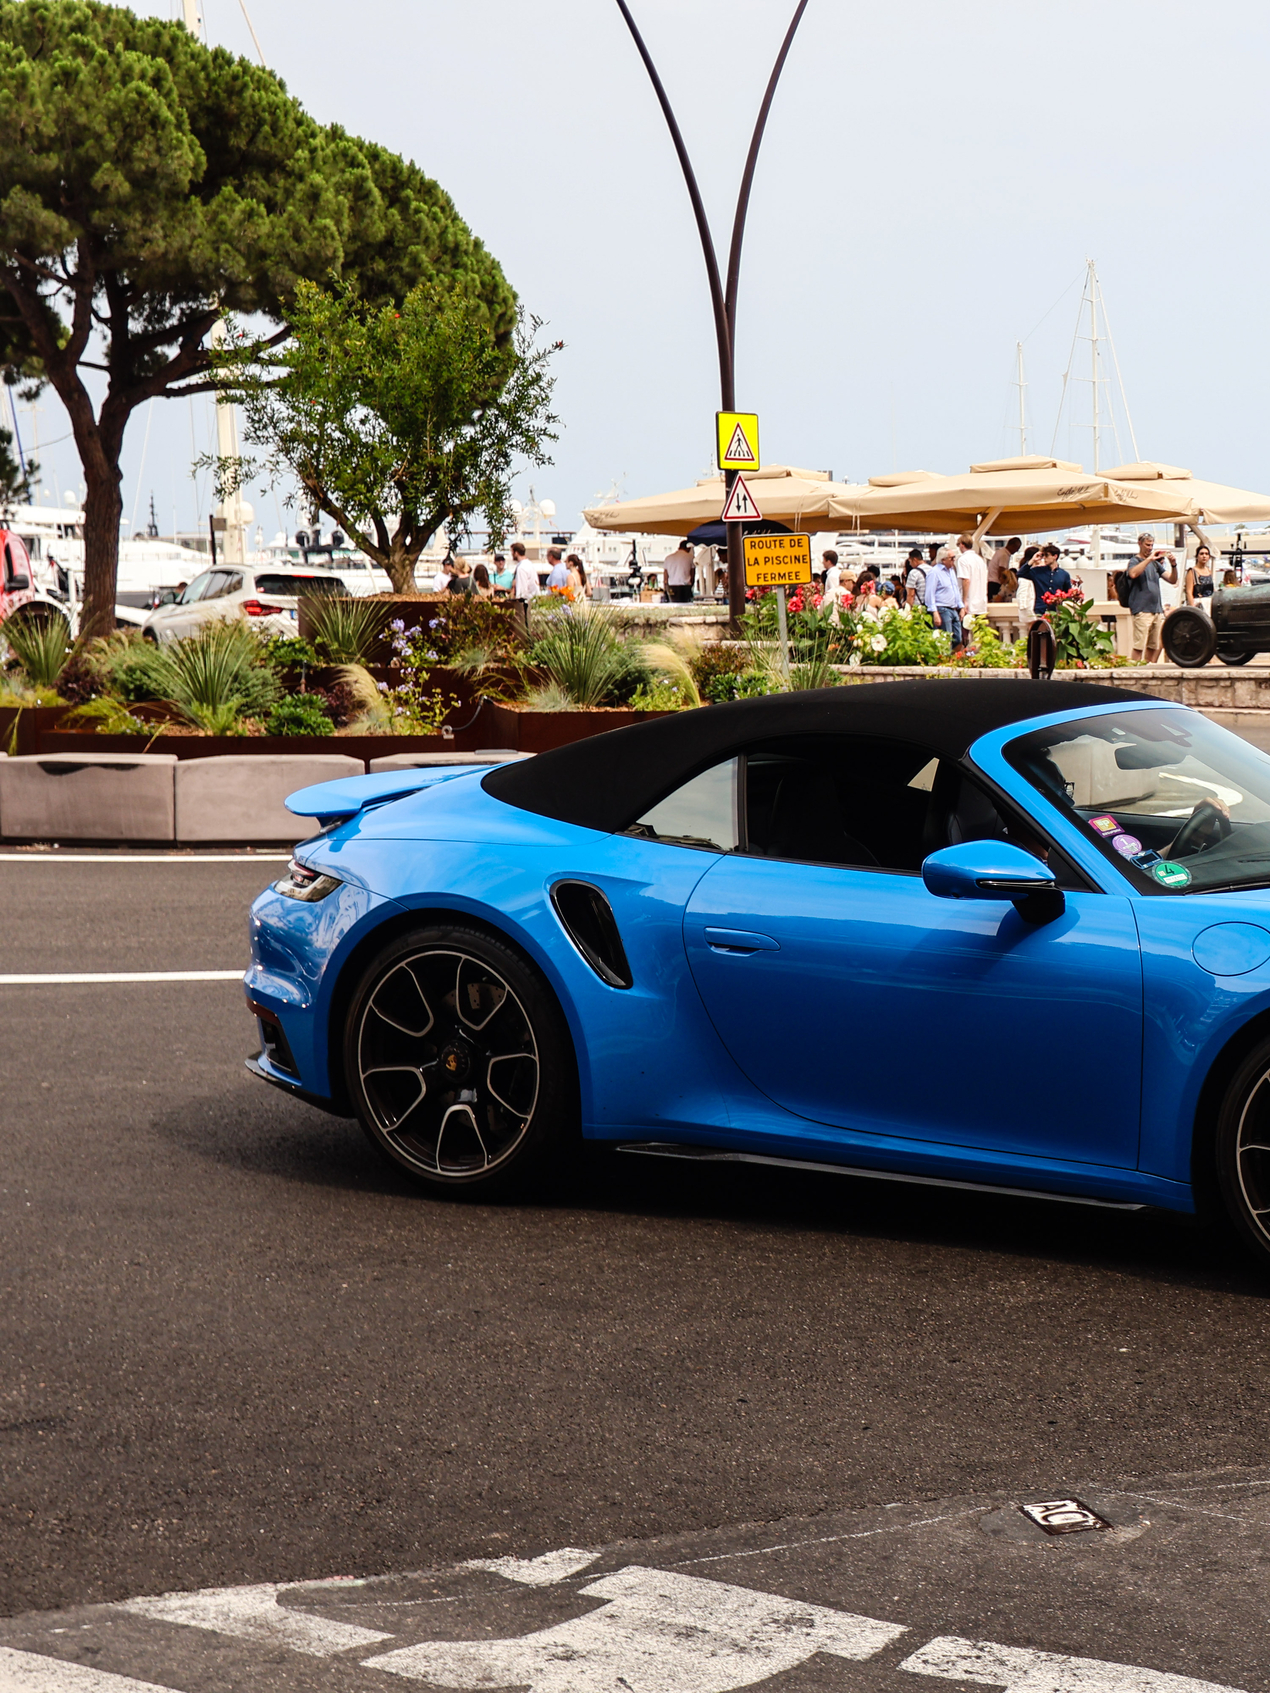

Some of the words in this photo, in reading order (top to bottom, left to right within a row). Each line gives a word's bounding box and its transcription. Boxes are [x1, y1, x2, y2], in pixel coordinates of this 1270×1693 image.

[750, 539, 785, 550] ROUTE
[789, 538, 804, 548] DE
[747, 557, 760, 567] LA
[764, 554, 808, 566] PISCINE
[756, 571, 801, 582] FERMEE
[1165, 865, 1175, 874] 4
